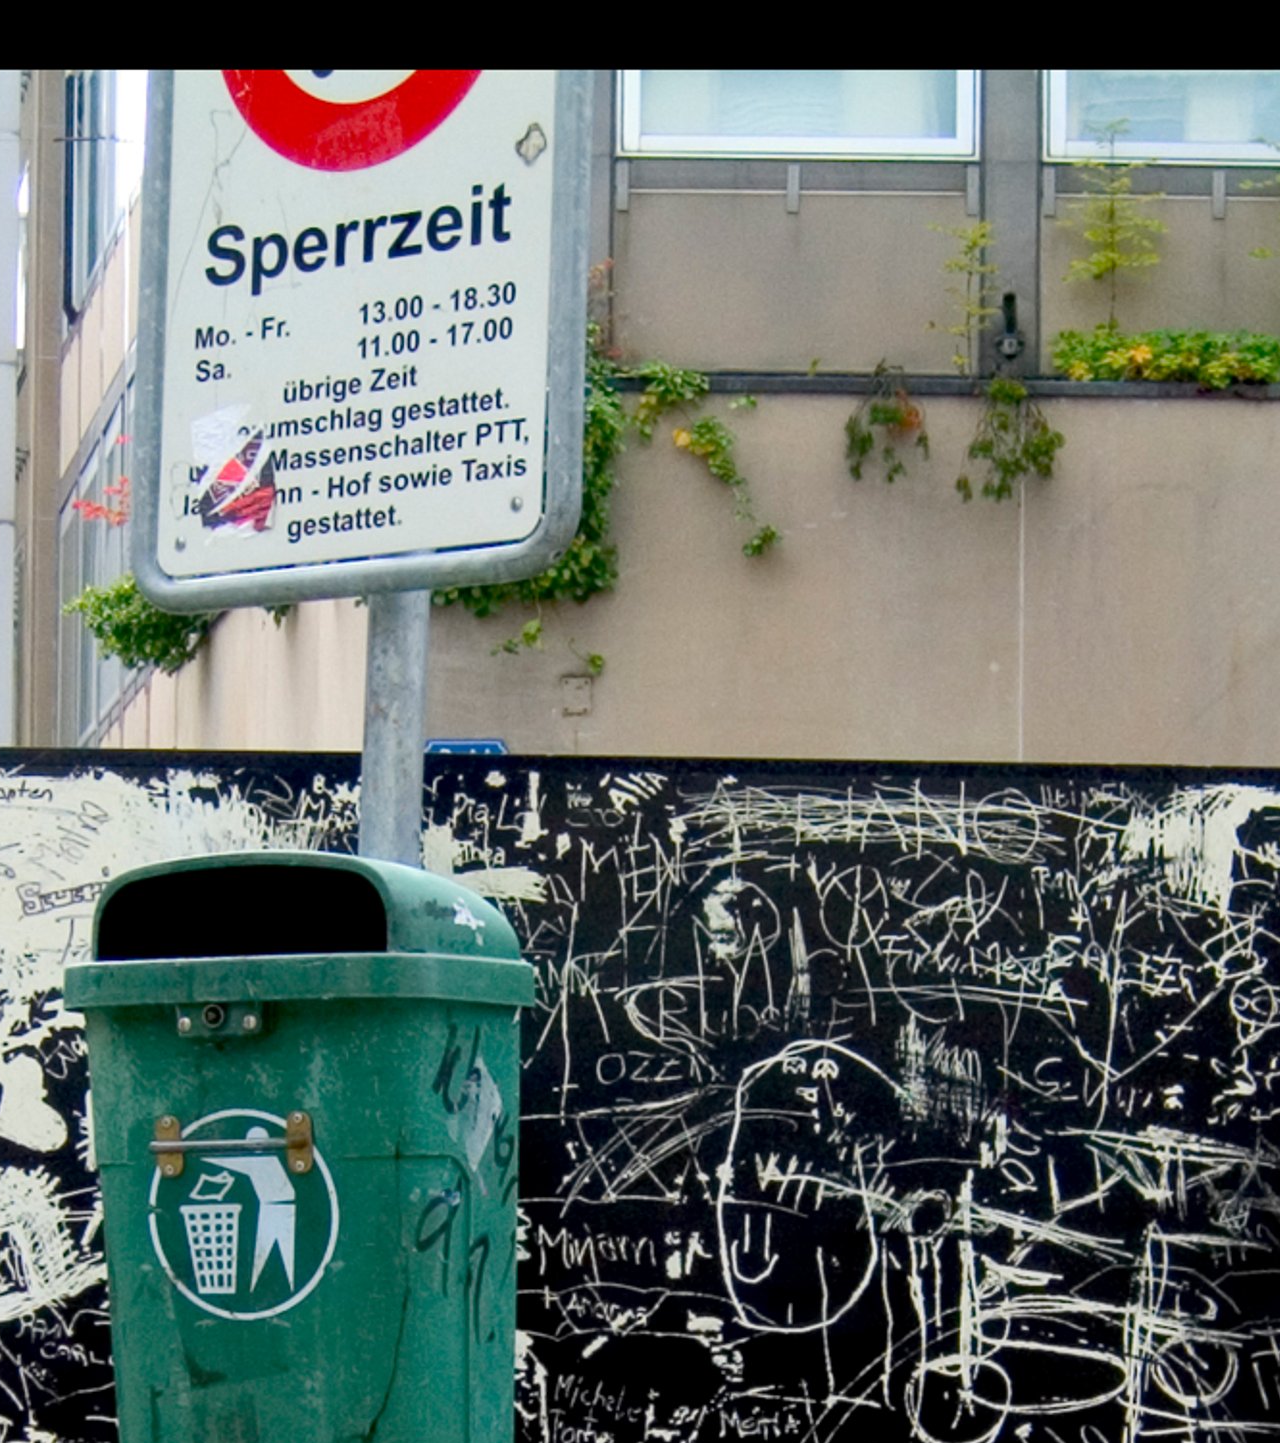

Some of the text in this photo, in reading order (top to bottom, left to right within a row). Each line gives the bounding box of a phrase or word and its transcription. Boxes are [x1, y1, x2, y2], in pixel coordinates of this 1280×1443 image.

[204, 182, 512, 296] Sperrzeit
[195, 326, 237, 349] Mo.
[261, 317, 290, 340] Fr.
[358, 296, 423, 324] 13.00
[449, 281, 516, 312] 18.30
[195, 360, 232, 383] Sa.
[357, 330, 420, 359] 11.00
[447, 316, 513, 347] 17.00
[283, 365, 418, 403] übrige Zeit
[391, 388, 510, 424] gestattet.
[270, 429, 468, 472] Massenschalter
[476, 418, 530, 446] PTT,
[327, 472, 370, 500] Hof
[379, 465, 453, 492] sowie
[461, 456, 527, 483] Taxis
[287, 504, 402, 543] gestattet.
